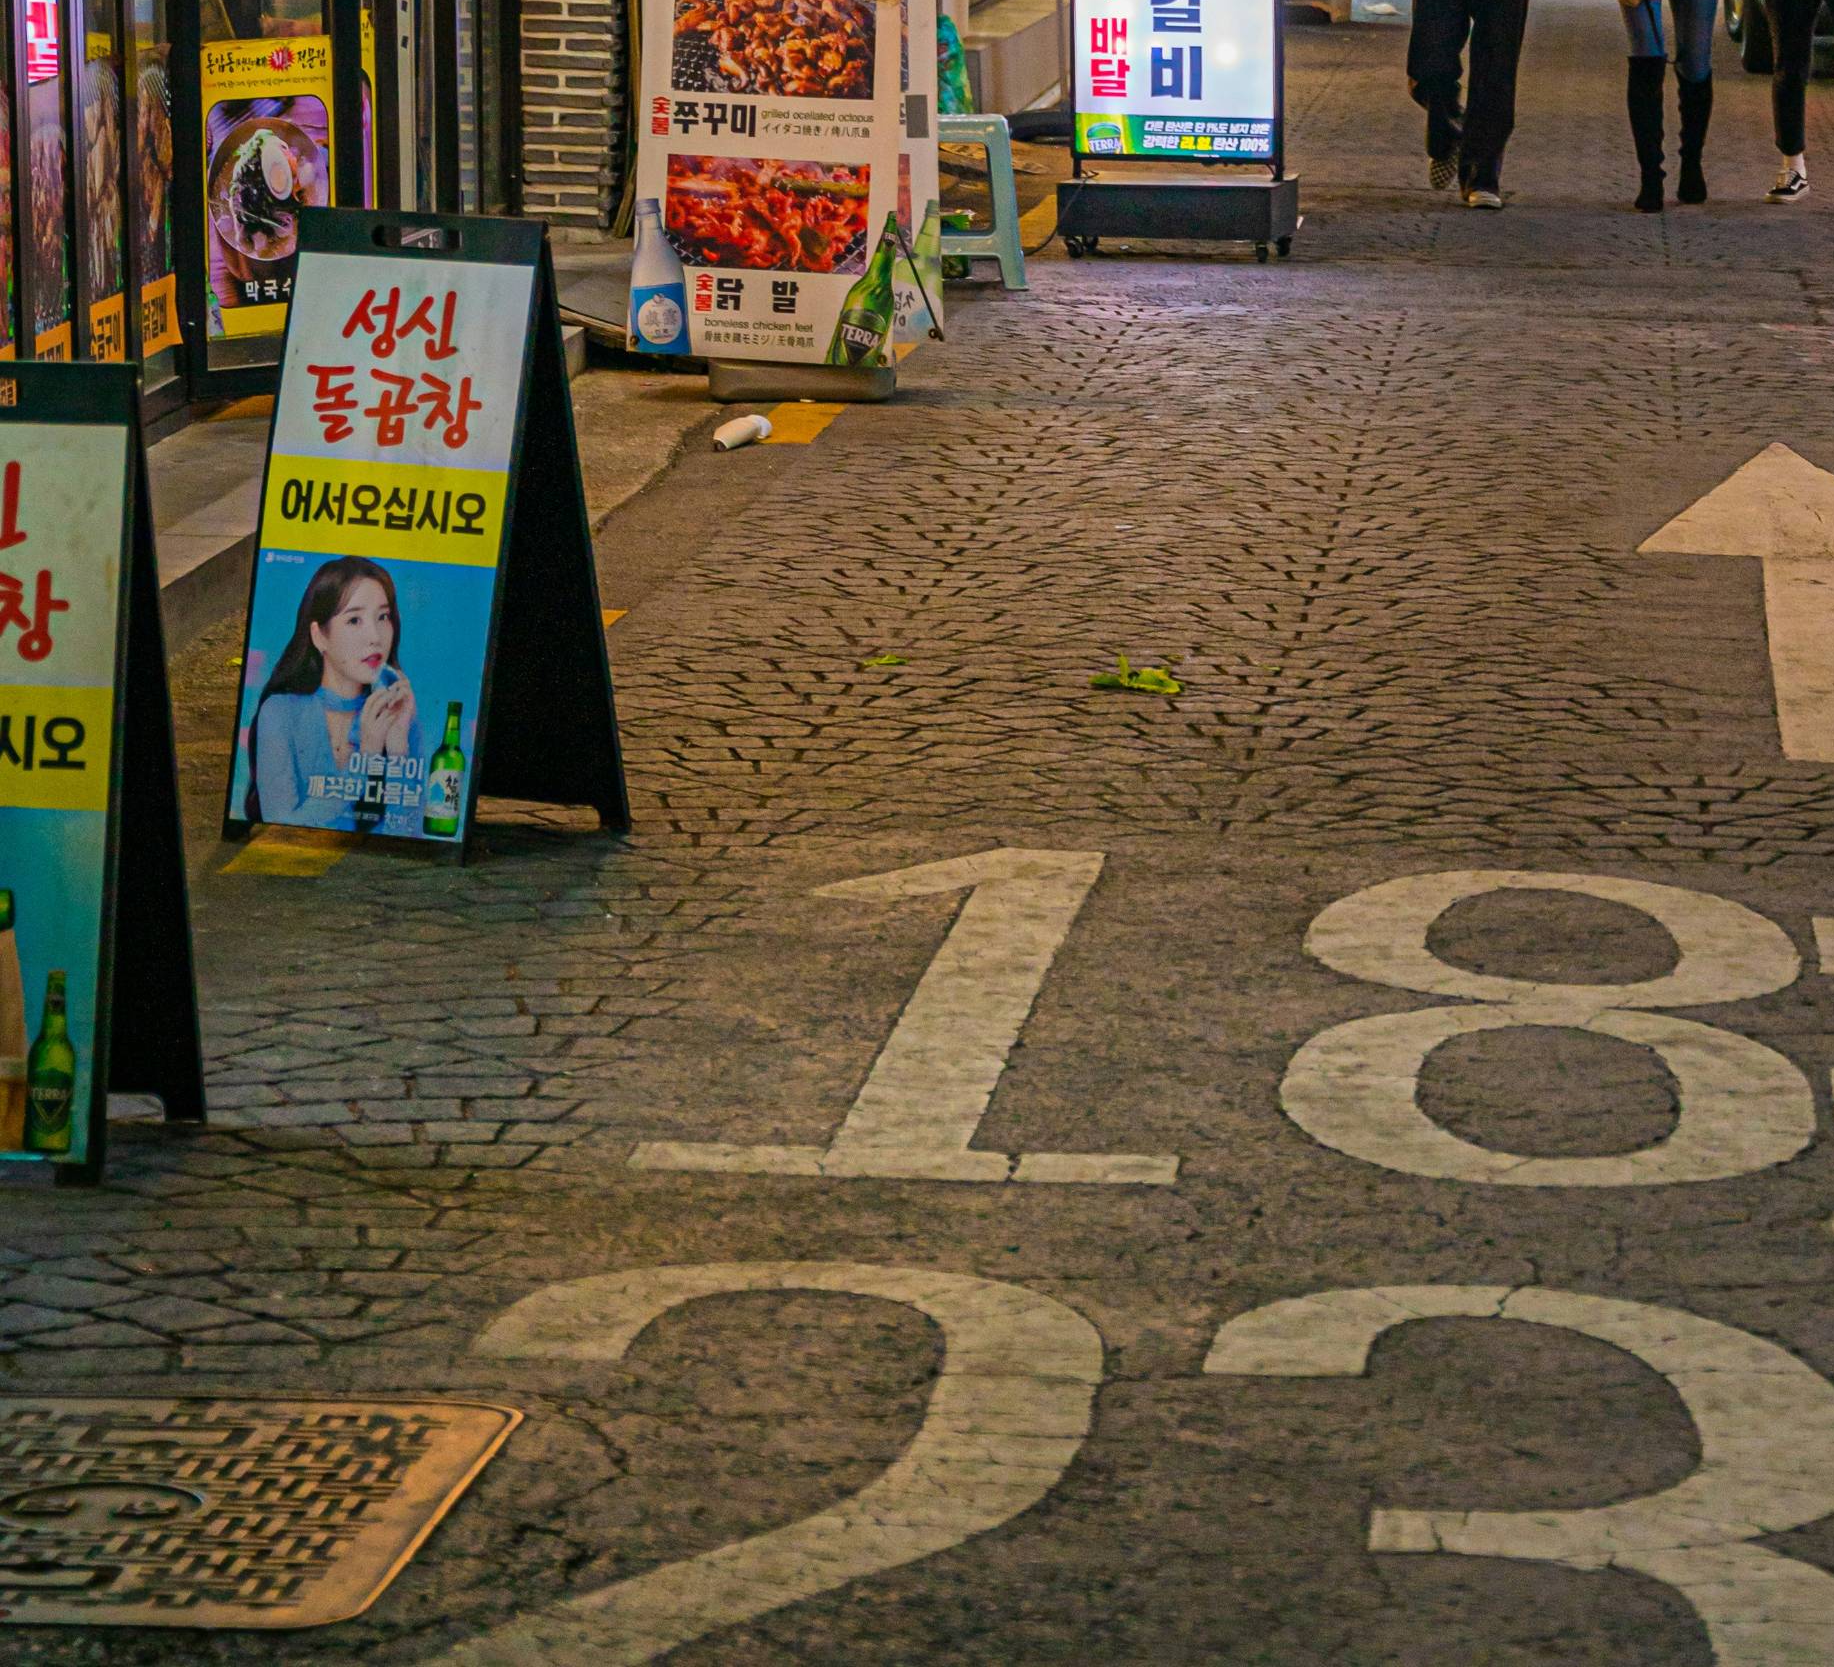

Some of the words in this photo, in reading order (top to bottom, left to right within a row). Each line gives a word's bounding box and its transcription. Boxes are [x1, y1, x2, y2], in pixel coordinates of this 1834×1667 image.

[673, 101, 756, 137] 쭈꾸미
[761, 108, 790, 121] grilled
[793, 110, 835, 122] ocellated
[838, 112, 874, 124] octopus
[1088, 138, 1123, 153] TERRA
[343, 286, 458, 361] 성신
[704, 318, 749, 331] boneless
[753, 320, 791, 333] chicken
[795, 322, 814, 334] feet
[841, 323, 882, 345] TERRA
[307, 364, 482, 450] 돌곱창
[280, 477, 487, 535] 어서오십시오
[349, 751, 426, 779] 이슬같이
